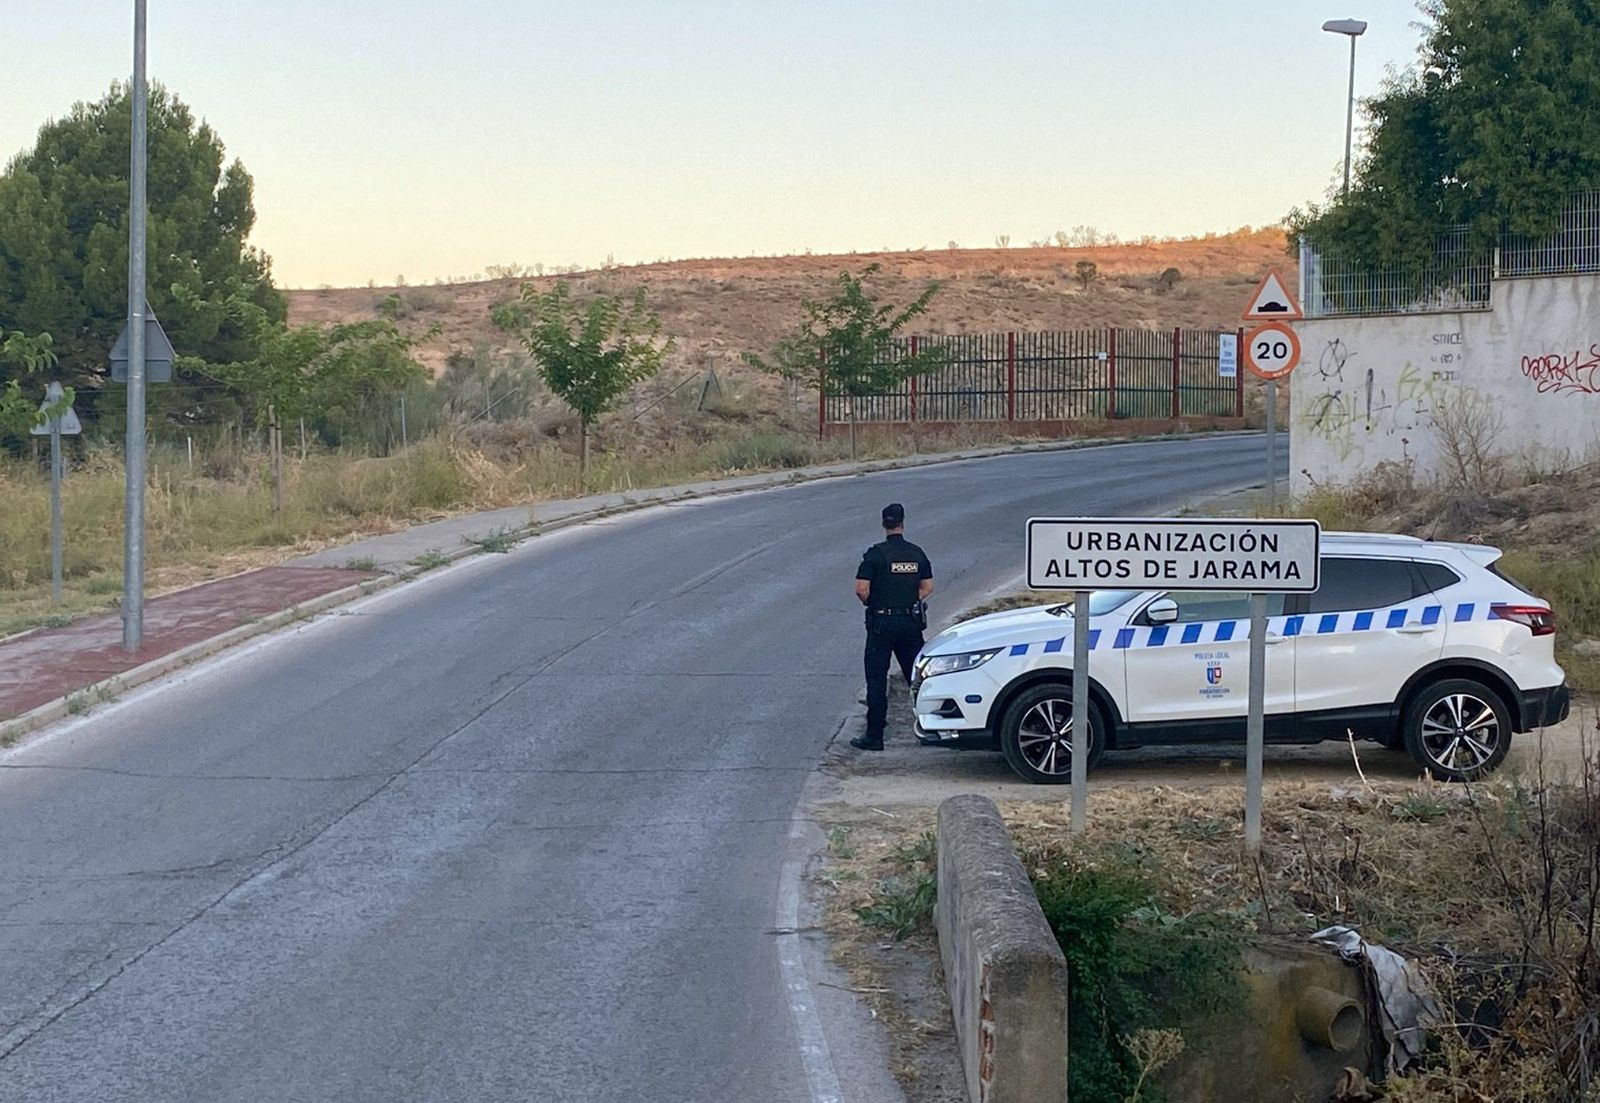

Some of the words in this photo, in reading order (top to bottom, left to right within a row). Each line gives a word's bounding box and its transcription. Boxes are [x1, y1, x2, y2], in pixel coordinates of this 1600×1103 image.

[1257, 341, 1288, 360] 20
[1067, 529, 1279, 553] URBANIZACIÓN
[1044, 559, 1131, 579] ALTOS
[1143, 559, 1178, 579] DE
[1188, 560, 1301, 580] JARAMA
